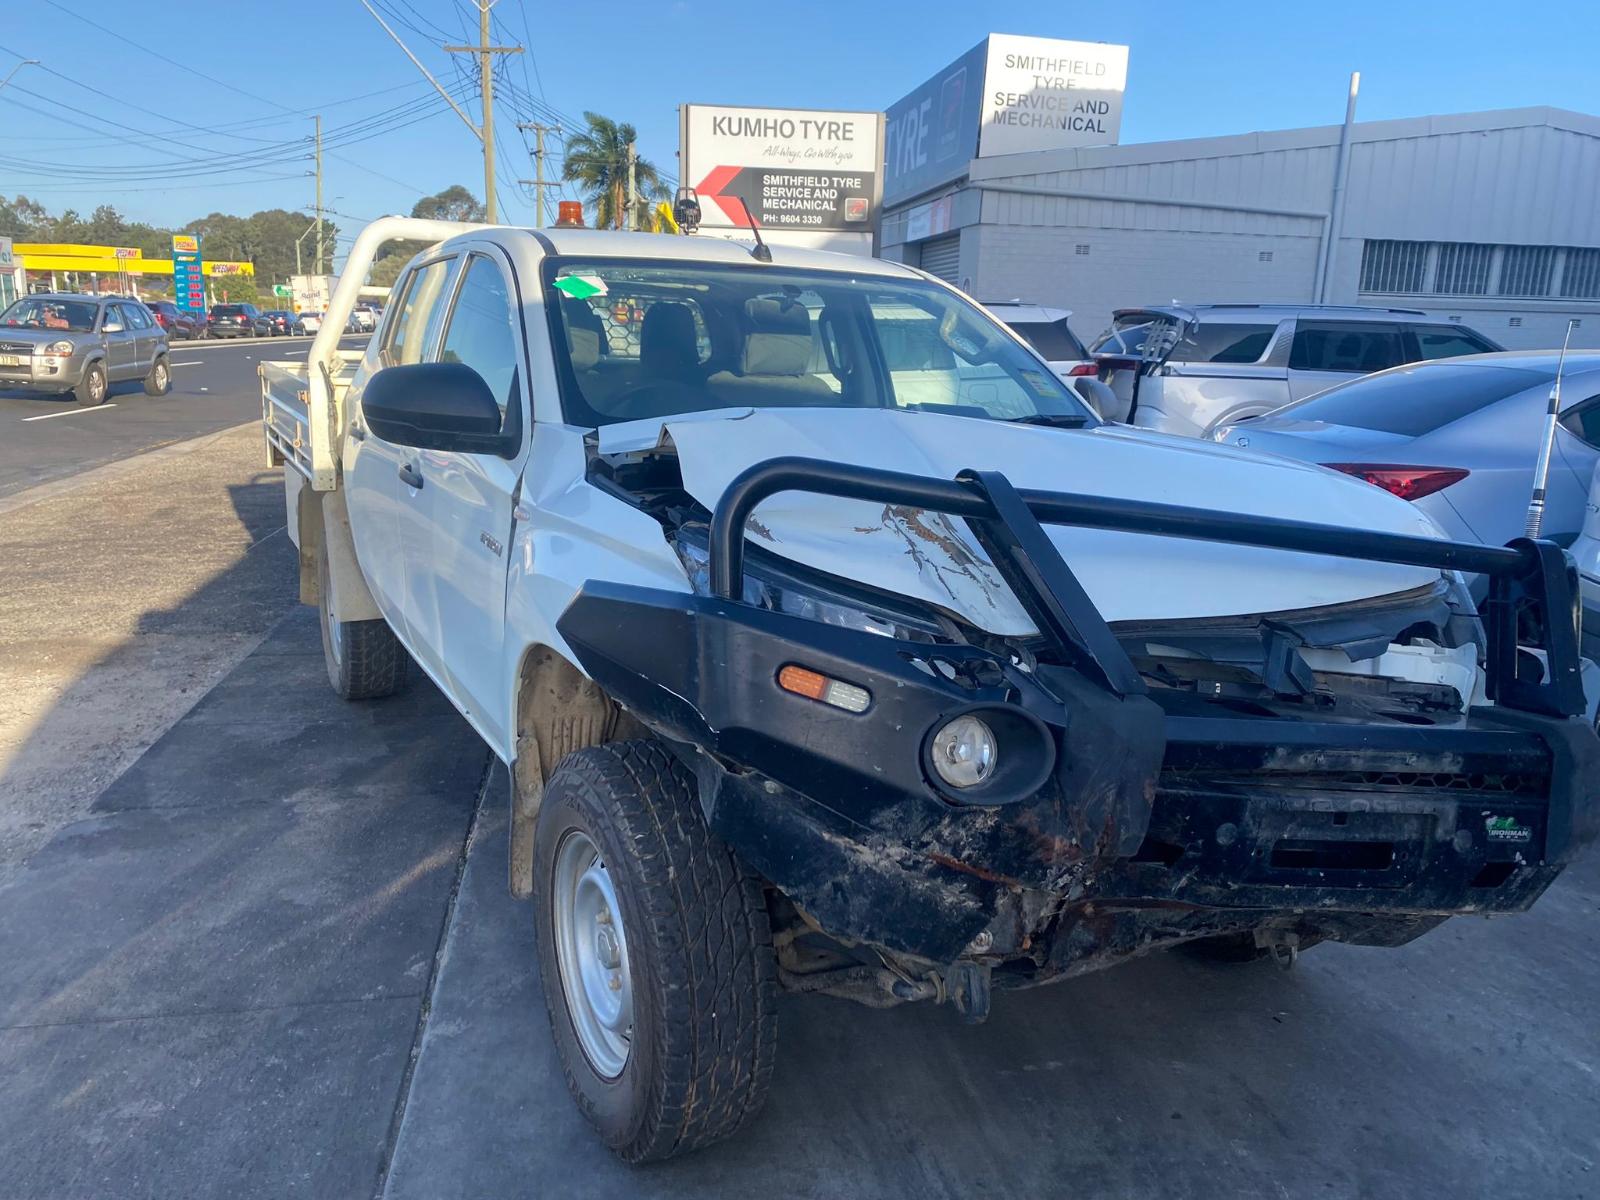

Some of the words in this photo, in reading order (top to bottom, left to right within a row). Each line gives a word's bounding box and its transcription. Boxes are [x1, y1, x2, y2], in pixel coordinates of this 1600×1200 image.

[1005, 54, 1106, 76] SMITHFIELD
[1033, 75, 1076, 91] TYRE
[994, 92, 1070, 112] SERVICE
[1073, 100, 1109, 115] AND
[713, 116, 795, 139] KUMHO
[799, 120, 854, 141] TYRE
[993, 110, 1106, 133] MECHANICAL
[804, 147, 817, 159] Go
[835, 152, 854, 165] you
[763, 174, 830, 188] SMITHFIELD
[832, 178, 861, 188] TYRE
[763, 187, 811, 198] SERVICE
[814, 189, 838, 200] AND
[763, 199, 837, 211] MECHANICAL
[763, 215, 779, 224] PH:
[780, 215, 800, 224] 9604
[802, 216, 822, 224] 3330
